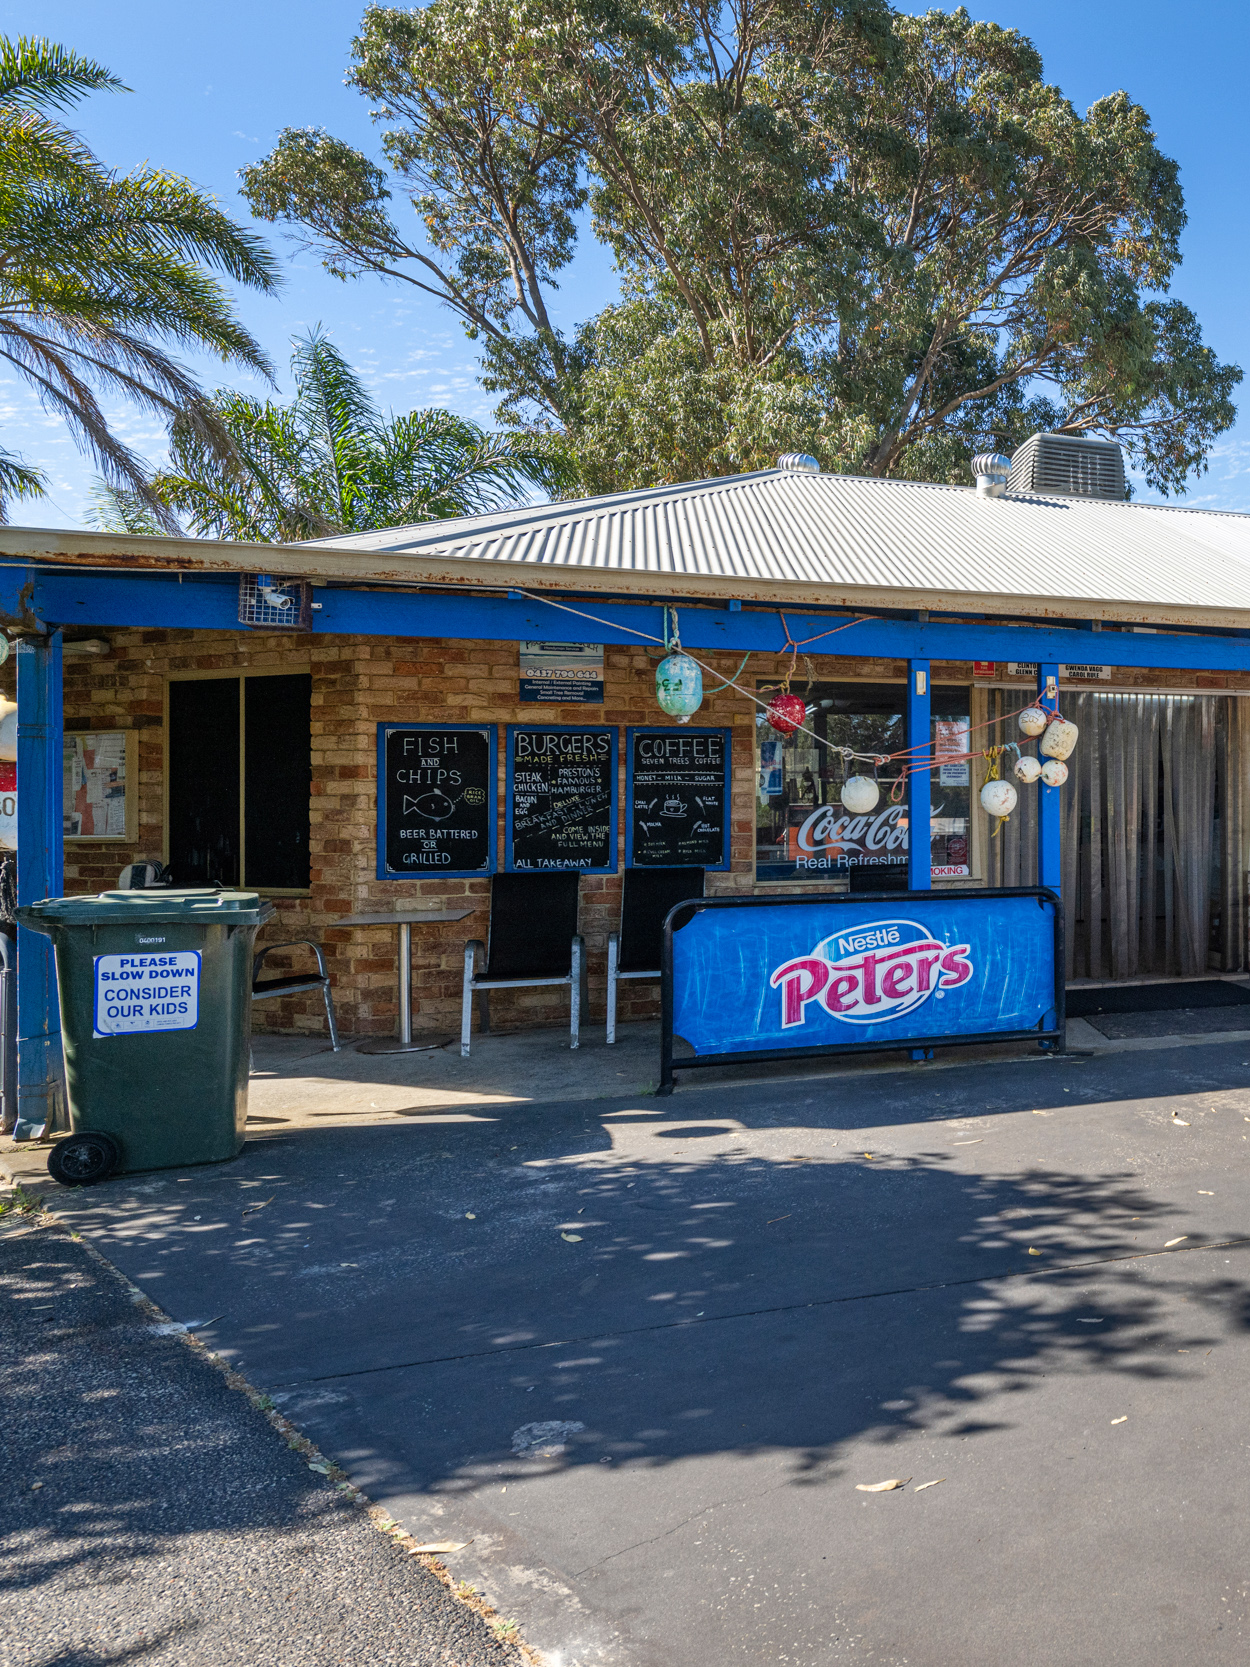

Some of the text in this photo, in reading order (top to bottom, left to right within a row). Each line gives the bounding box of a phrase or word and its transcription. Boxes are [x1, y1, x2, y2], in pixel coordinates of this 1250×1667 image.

[526, 669, 598, 679] 0437 796 644
[404, 737, 458, 755] FISH
[518, 735, 609, 756] BURGERS
[639, 739, 720, 758] COFFEE
[560, 754, 598, 762] FRESH
[397, 770, 461, 785] CHIPS
[515, 772, 543, 782] STEAK
[559, 768, 600, 777] PRESTON'S
[514, 782, 548, 792] CHICKEN
[551, 786, 602, 794] HAMBURGER
[515, 796, 537, 804] BACON
[553, 795, 580, 809] DELUXE
[515, 808, 567, 831] BREAKFAST
[540, 806, 593, 829] AND DINNER
[400, 829, 478, 839] BEER BATTERED
[797, 804, 944, 852] Coca-Co
[403, 853, 451, 864] GRILLED
[516, 858, 592, 868] ALL TAKEAWAY
[796, 852, 931, 869] Real Refreshm
[838, 926, 901, 954] Nestlé
[120, 957, 177, 968] PLEASE
[101, 968, 195, 981] SLOW DOWN
[772, 941, 973, 1026] Peters
[104, 985, 192, 1001] CONSIDER
[107, 1002, 188, 1018] OUR KIDS
